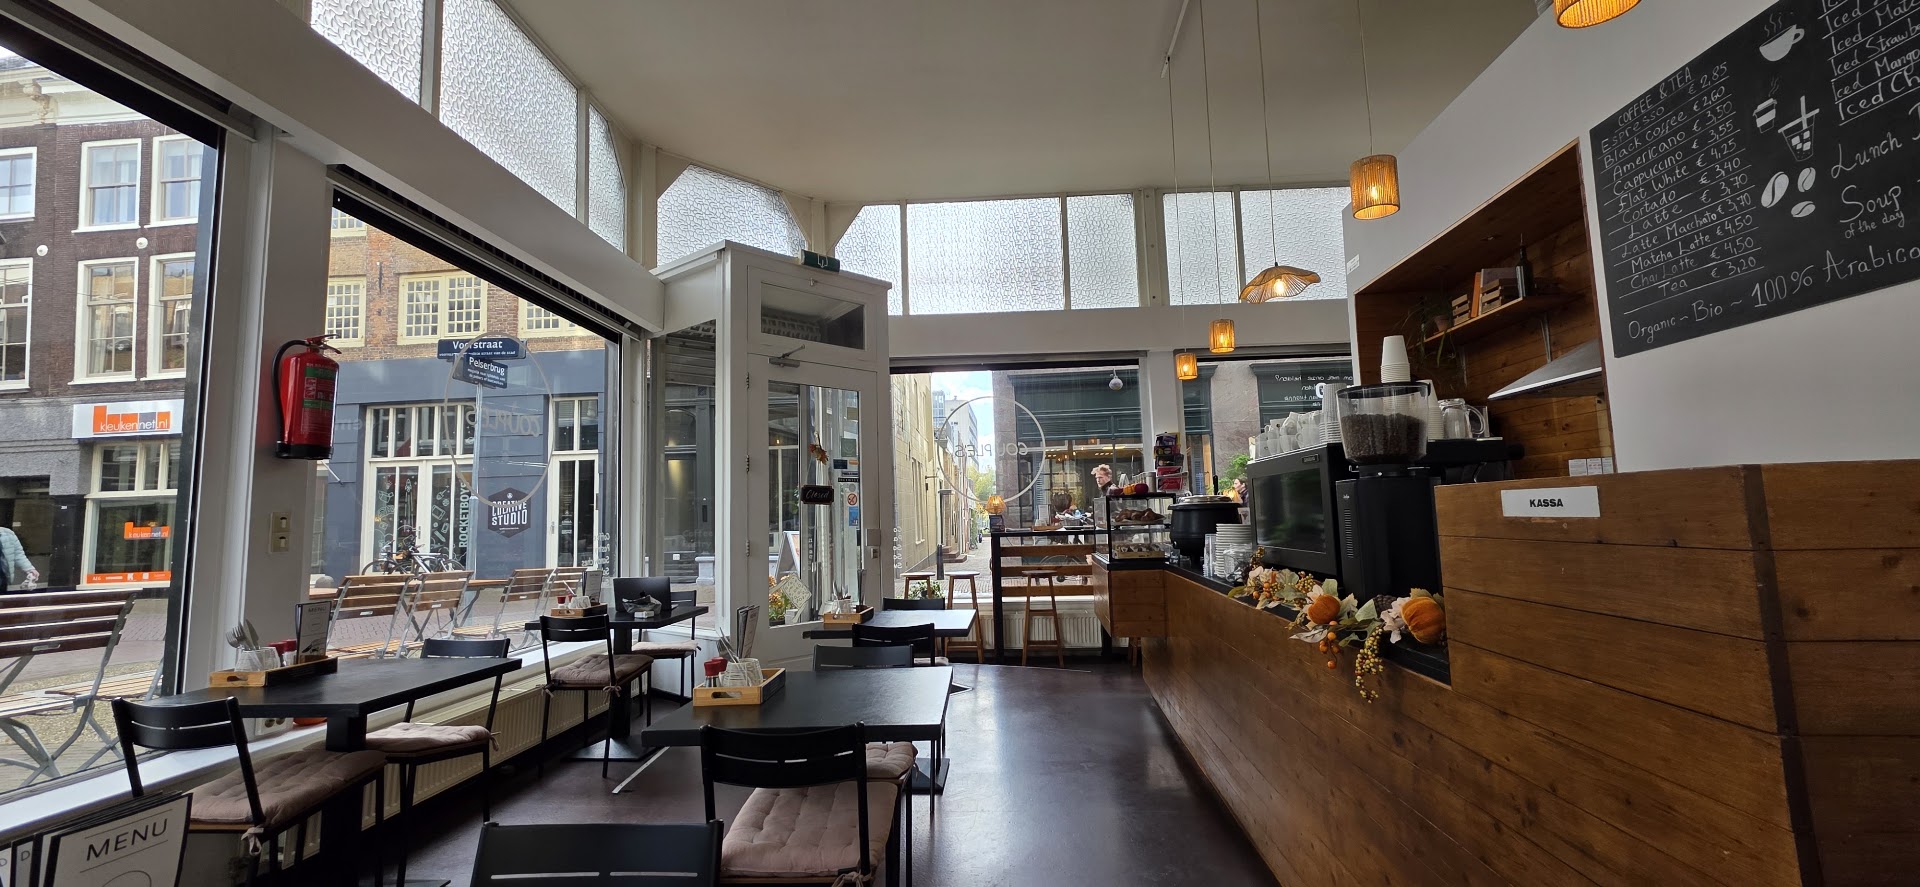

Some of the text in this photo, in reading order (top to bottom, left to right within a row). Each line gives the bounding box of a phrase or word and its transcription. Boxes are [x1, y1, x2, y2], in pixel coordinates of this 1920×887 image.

[1831, 22, 1862, 55] Iced
[1831, 49, 1861, 76] Iced
[1618, 93, 1653, 127] COFFEE
[1668, 66, 1693, 92] TEA
[1832, 71, 1864, 101] Iced
[1839, 81, 1884, 121] Iced
[1600, 106, 1665, 154] Espresso
[1603, 137, 1643, 169] Black
[1613, 131, 1686, 181] Americano
[1831, 131, 1903, 179] Lunch
[1613, 151, 1683, 196] Cappuccino
[1651, 165, 1690, 192] White
[1622, 190, 1677, 224] Cortado
[1840, 184, 1902, 223] Soup
[1621, 235, 1660, 259] Latte
[1665, 210, 1717, 241] Macchiato
[1628, 204, 1683, 240] Latte
[1844, 209, 1905, 239] of the day
[1631, 250, 1673, 274] Matcha
[1678, 232, 1711, 256] Latte
[1630, 271, 1658, 290] Chai
[1662, 256, 1699, 279] Latte
[1658, 278, 1688, 297] Tea
[1628, 316, 1676, 344] Organic
[1691, 299, 1723, 322] Bio
[1751, 264, 1815, 308] 100%
[469, 356, 505, 376] Pelserbrug
[491, 509, 528, 526] STUDIO
[1529, 498, 1564, 508] KASSA
[86, 818, 168, 861] MENU
